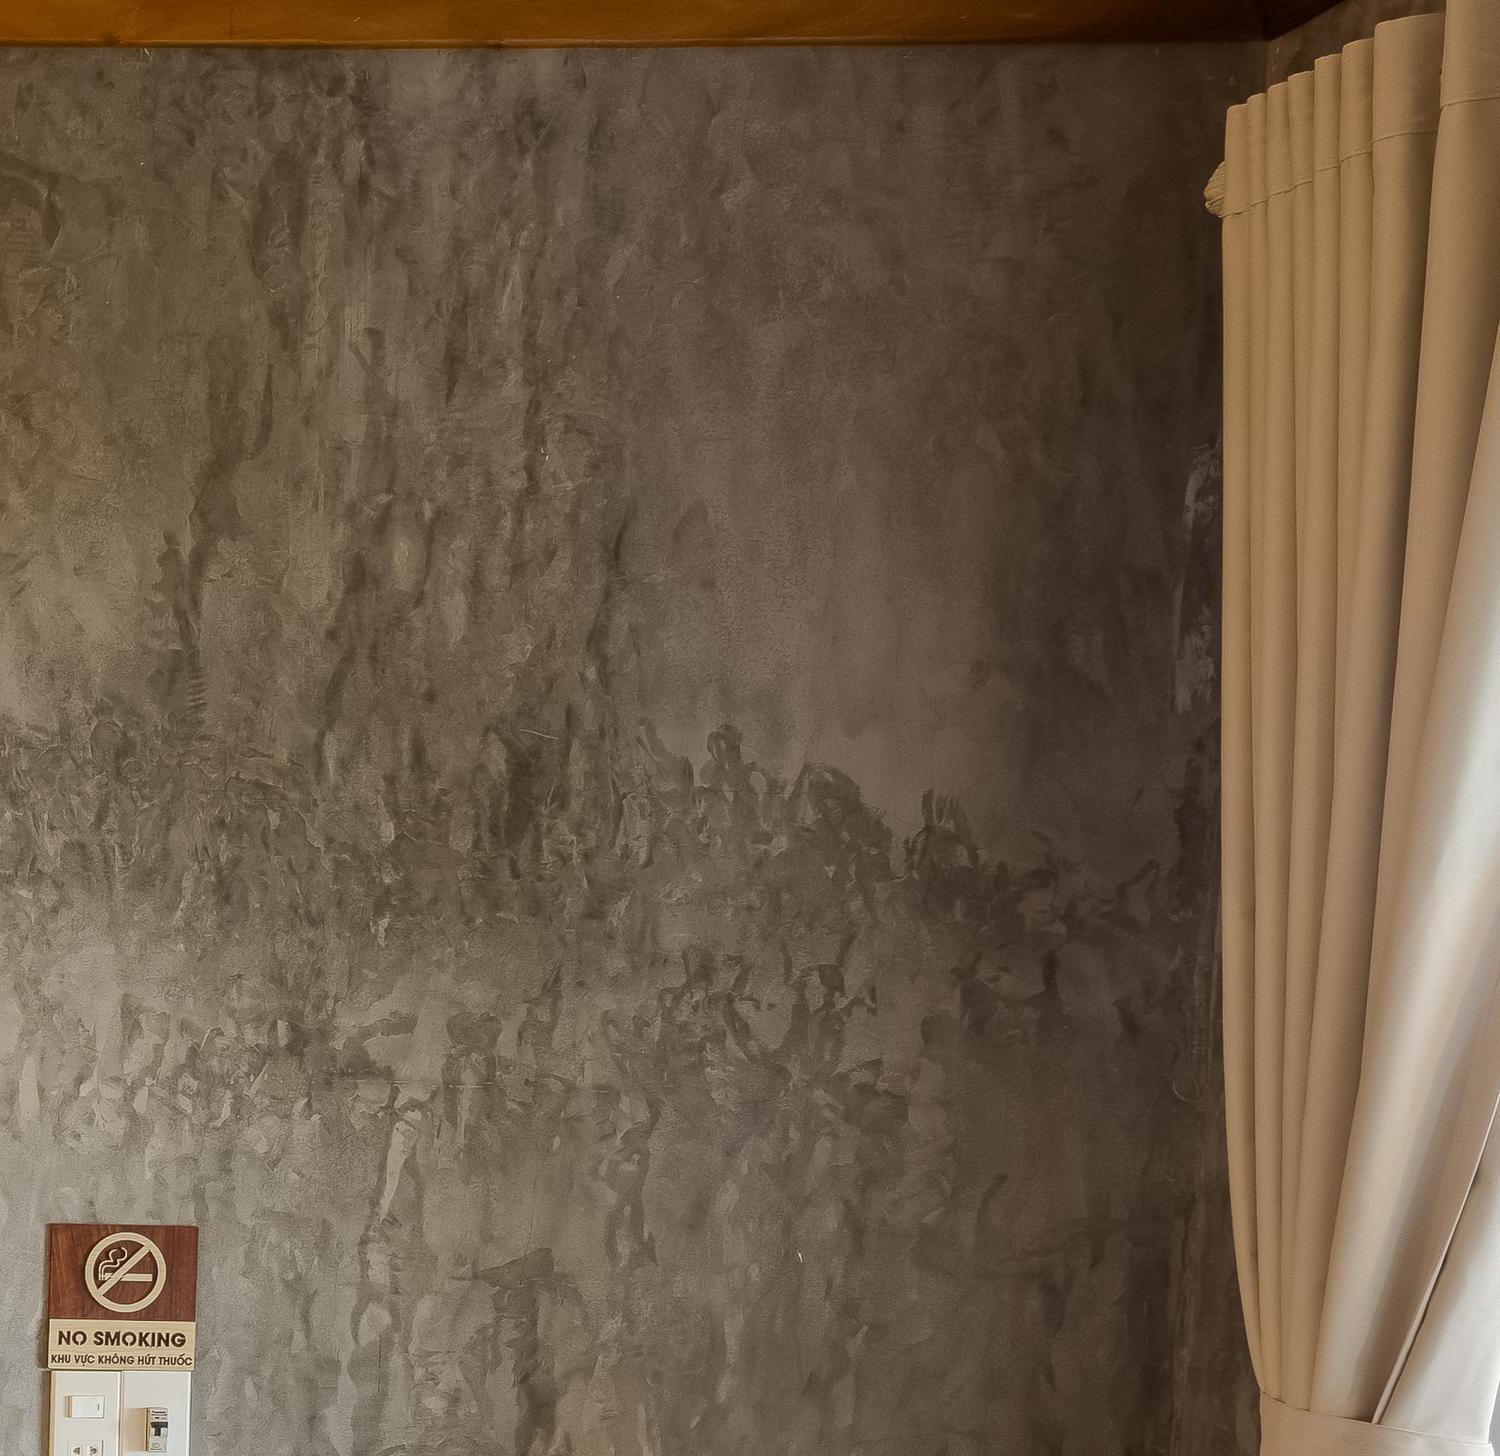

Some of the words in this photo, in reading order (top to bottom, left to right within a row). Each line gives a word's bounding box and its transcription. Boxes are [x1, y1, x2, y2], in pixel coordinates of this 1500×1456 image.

[57, 1330, 88, 1346] NO
[93, 1330, 187, 1348] SMOKING
[51, 1354, 71, 1363] KHU
[74, 1354, 95, 1366] VỰC
[98, 1353, 135, 1365] KHÔNG
[137, 1354, 156, 1366] HÚT
[159, 1353, 193, 1366] THUỐC
